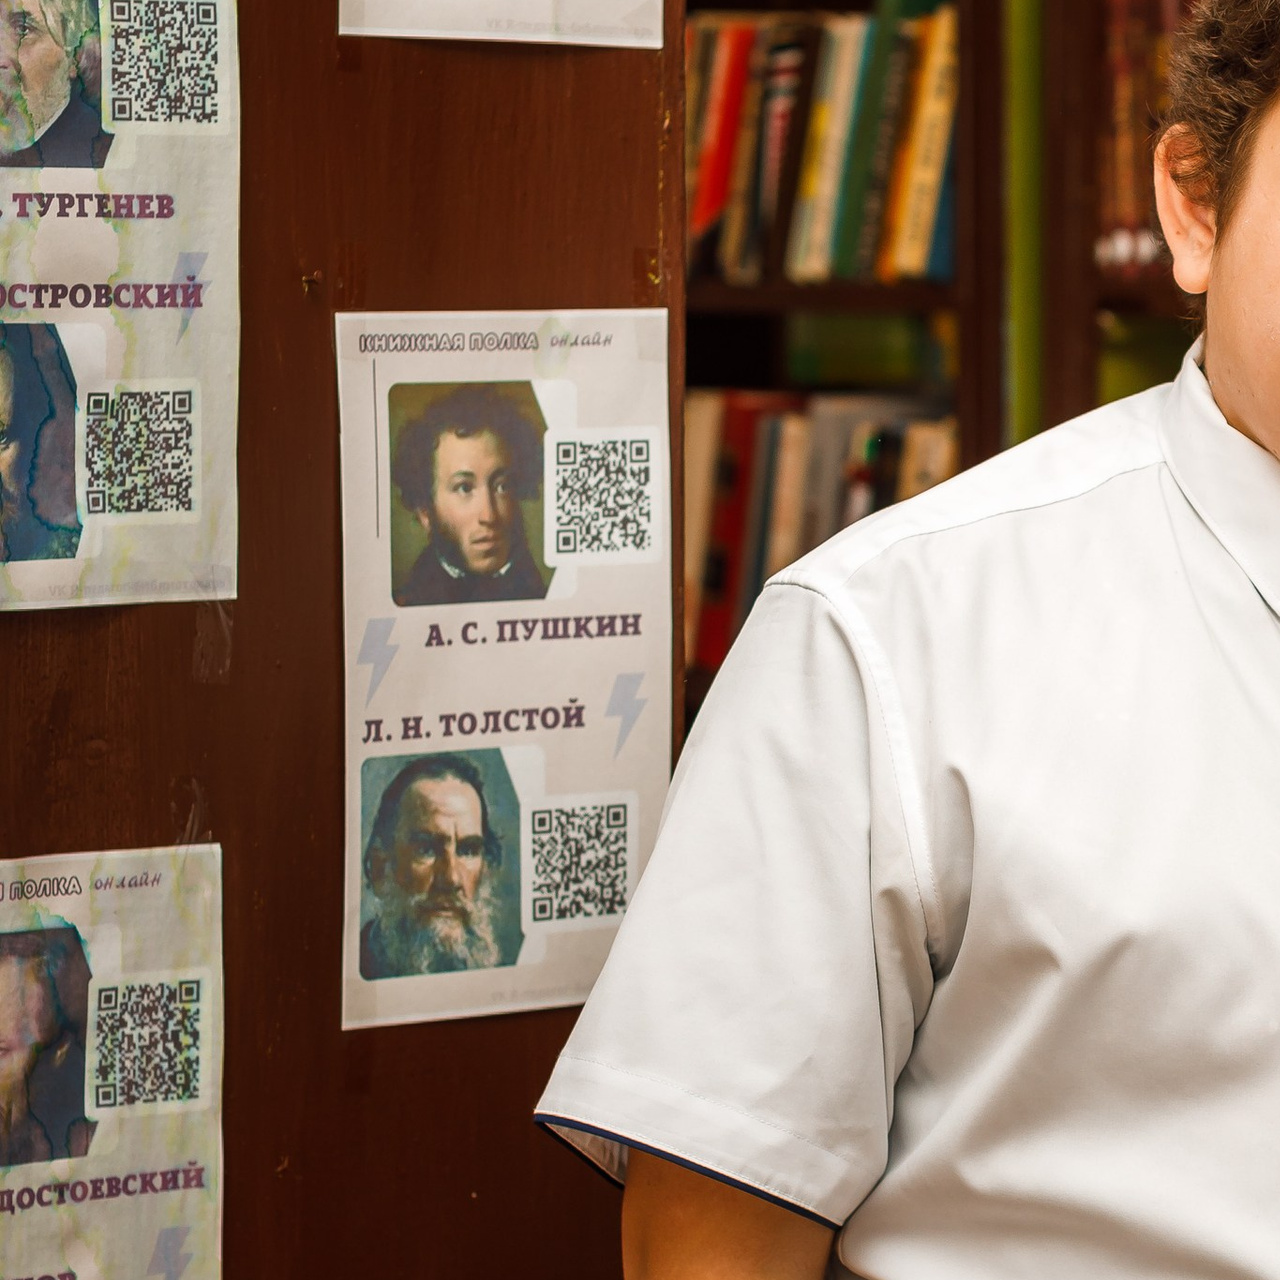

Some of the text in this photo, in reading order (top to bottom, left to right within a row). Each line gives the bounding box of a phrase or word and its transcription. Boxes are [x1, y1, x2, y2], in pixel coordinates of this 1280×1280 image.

[12, 192, 175, 219] ТУРГЕНЕВ
[0, 275, 203, 309] СТРОВСКИЙ
[359, 333, 465, 353] КНИЖНАЯ
[469, 332, 539, 352] ПОЛКА
[424, 613, 643, 647] А. С. ПУШКИН
[362, 697, 586, 744] Л. Н. ТОЛСТОЙ
[9, 876, 82, 901] ПОЛКА
[0, 1160, 205, 1214] ДОСТОЕВСКИЙ
